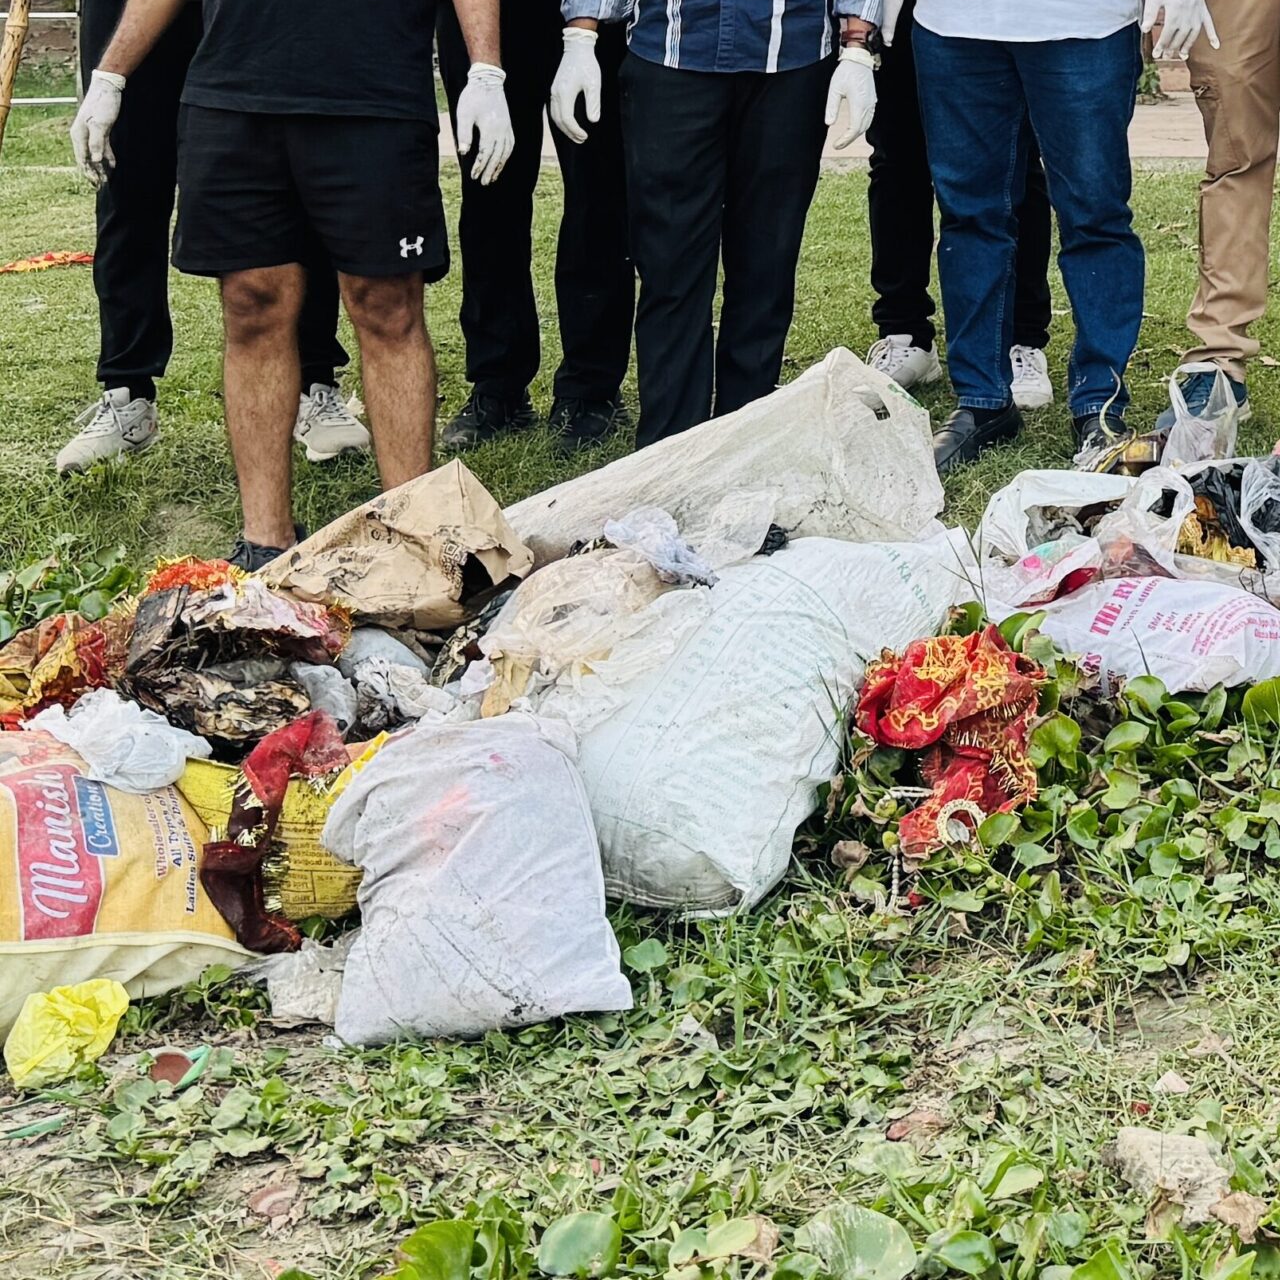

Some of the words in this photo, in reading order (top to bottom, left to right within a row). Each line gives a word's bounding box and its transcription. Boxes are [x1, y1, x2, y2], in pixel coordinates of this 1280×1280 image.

[1089, 601, 1123, 636] THE
[87, 783, 112, 848] Creation
[164, 810, 179, 843] Types
[17, 770, 89, 919] Manish
[148, 808, 168, 877] Wholesaler
[170, 848, 182, 867] All
[183, 831, 196, 862] Suits
[186, 867, 197, 913] Ladies
